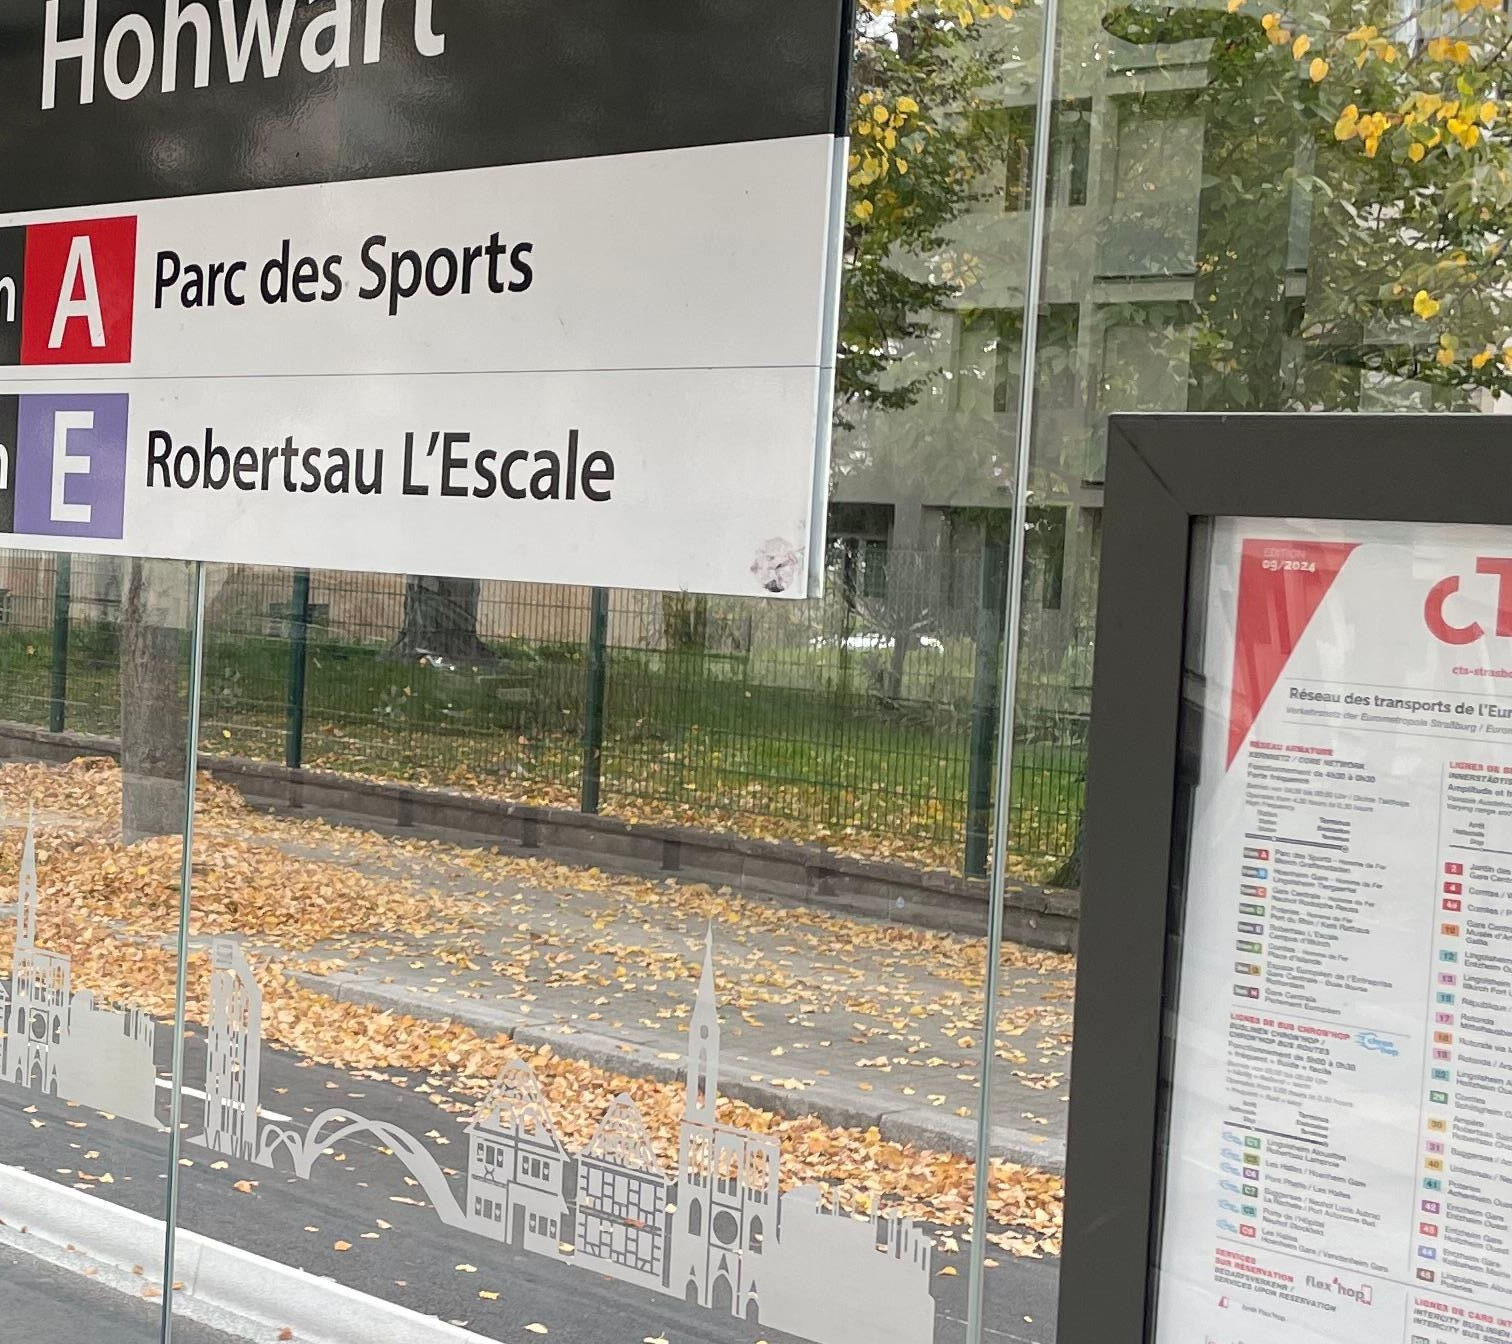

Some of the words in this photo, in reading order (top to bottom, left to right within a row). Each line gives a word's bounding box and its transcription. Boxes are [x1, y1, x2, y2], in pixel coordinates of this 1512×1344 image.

[47, 235, 106, 349] A
[154, 250, 247, 309] Parc
[260, 239, 343, 305] des
[358, 231, 534, 316] Sports
[50, 410, 95, 523] E
[146, 427, 384, 495] Robertsau
[402, 429, 615, 502] L'Escale
[1262, 559, 1316, 573] 09/2024
[1289, 687, 1340, 702] Réseau
[1344, 692, 1370, 706] des
[1374, 694, 1451, 713] transports
[1454, 702, 1475, 715] de
[1215, 1248, 1256, 1265] SERVICES
